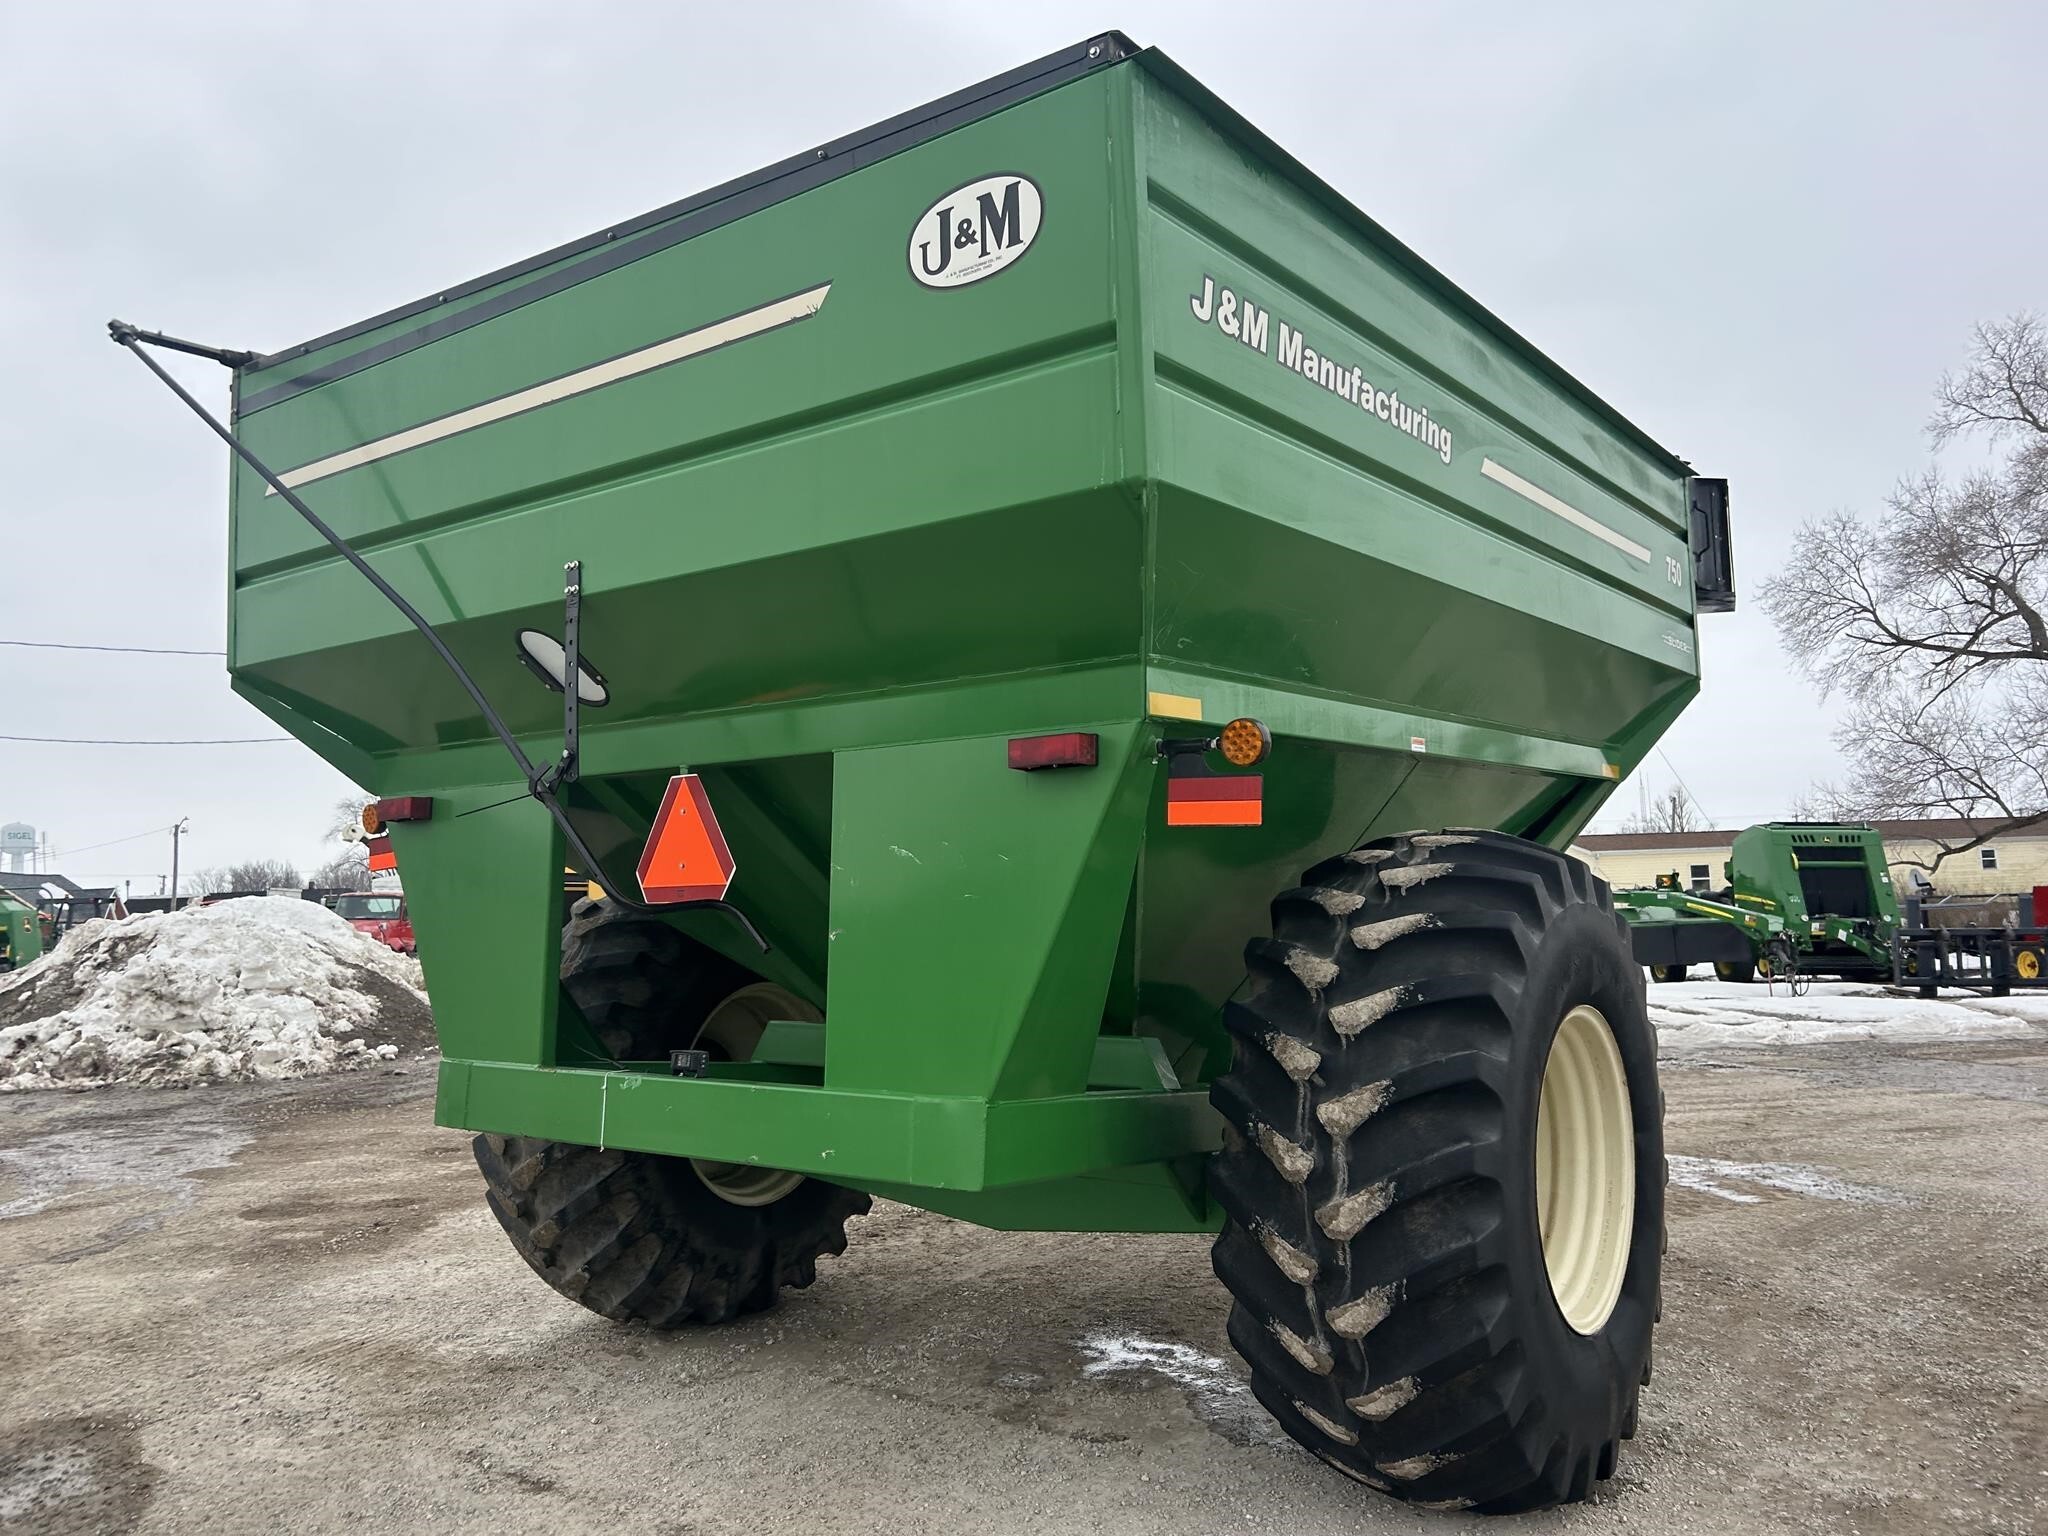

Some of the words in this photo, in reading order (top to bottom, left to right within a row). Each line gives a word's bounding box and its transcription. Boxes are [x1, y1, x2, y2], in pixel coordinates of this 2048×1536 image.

[919, 180, 1023, 276] J&M
[1190, 275, 1269, 355] J&M
[1278, 320, 1452, 464] Manufacturing
[1665, 556, 1682, 587] 750
